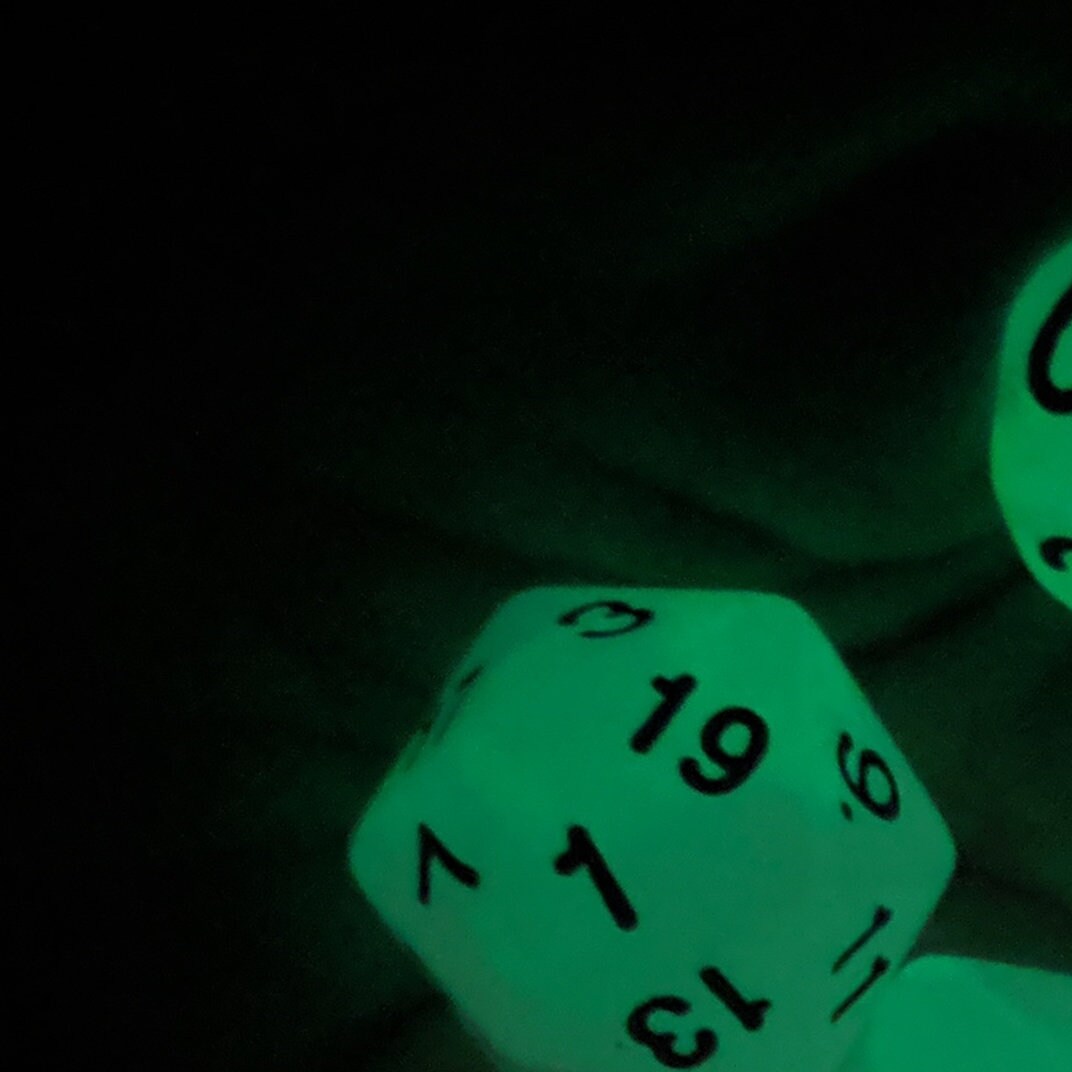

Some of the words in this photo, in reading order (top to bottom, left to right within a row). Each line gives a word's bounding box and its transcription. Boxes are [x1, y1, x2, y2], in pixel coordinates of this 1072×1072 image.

[629, 673, 770, 796] 19
[554, 824, 639, 932] 1
[626, 965, 772, 1070] 13
[831, 905, 892, 1023] 11
